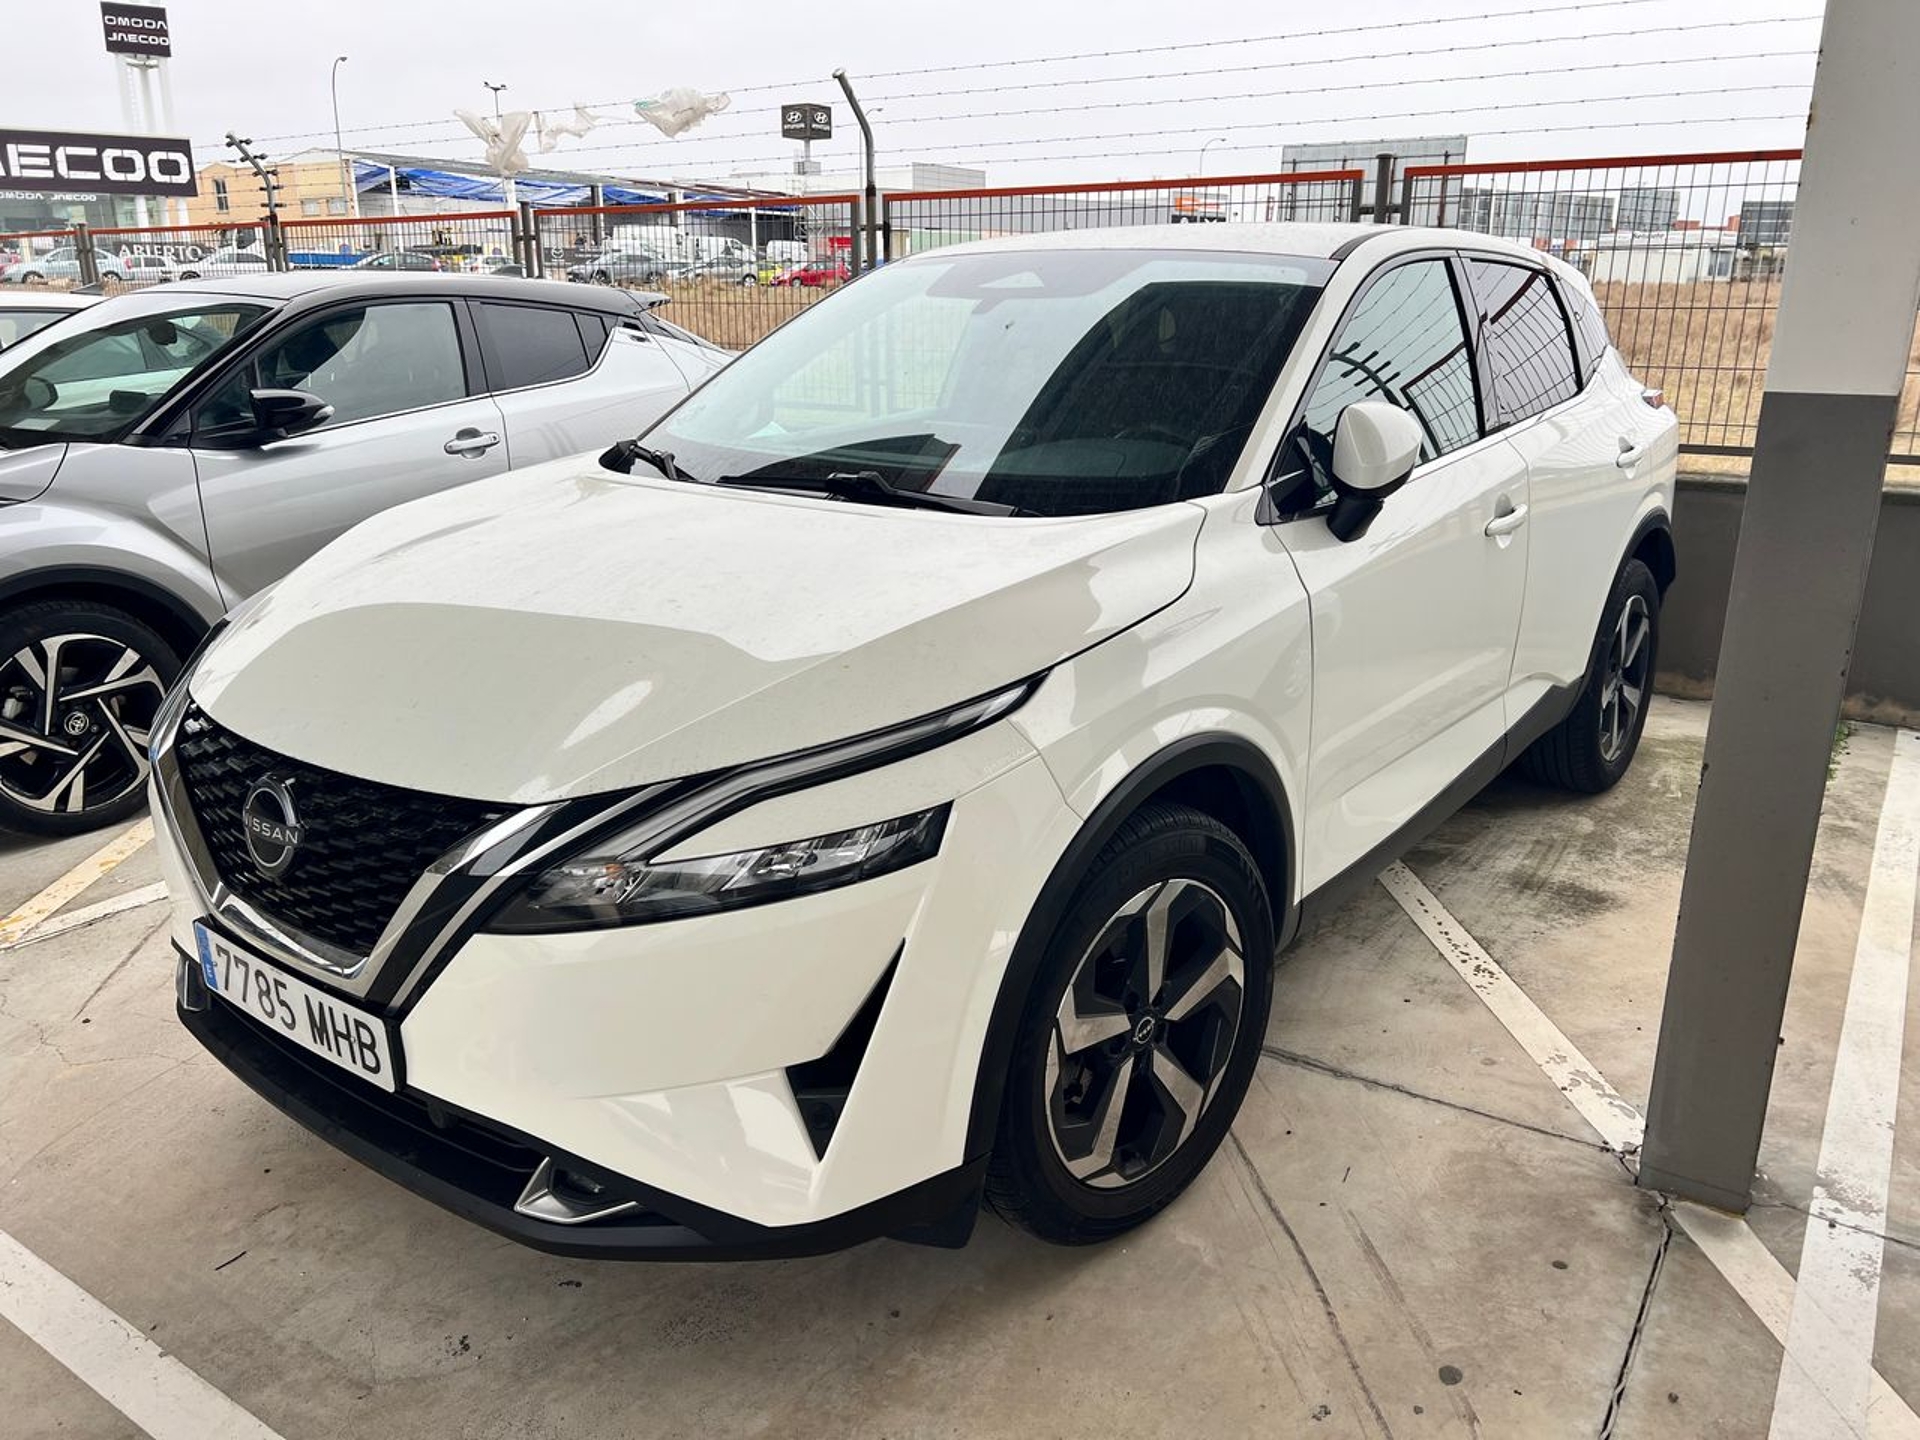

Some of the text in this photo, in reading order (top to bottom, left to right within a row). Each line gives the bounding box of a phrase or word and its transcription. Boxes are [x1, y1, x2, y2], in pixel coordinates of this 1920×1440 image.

[104, 15, 168, 30] OMODA
[107, 32, 169, 46] JAECOO
[0, 143, 191, 184] ECOO
[119, 244, 203, 262] ABIERTO
[215, 943, 381, 1075] 7785 MHB
